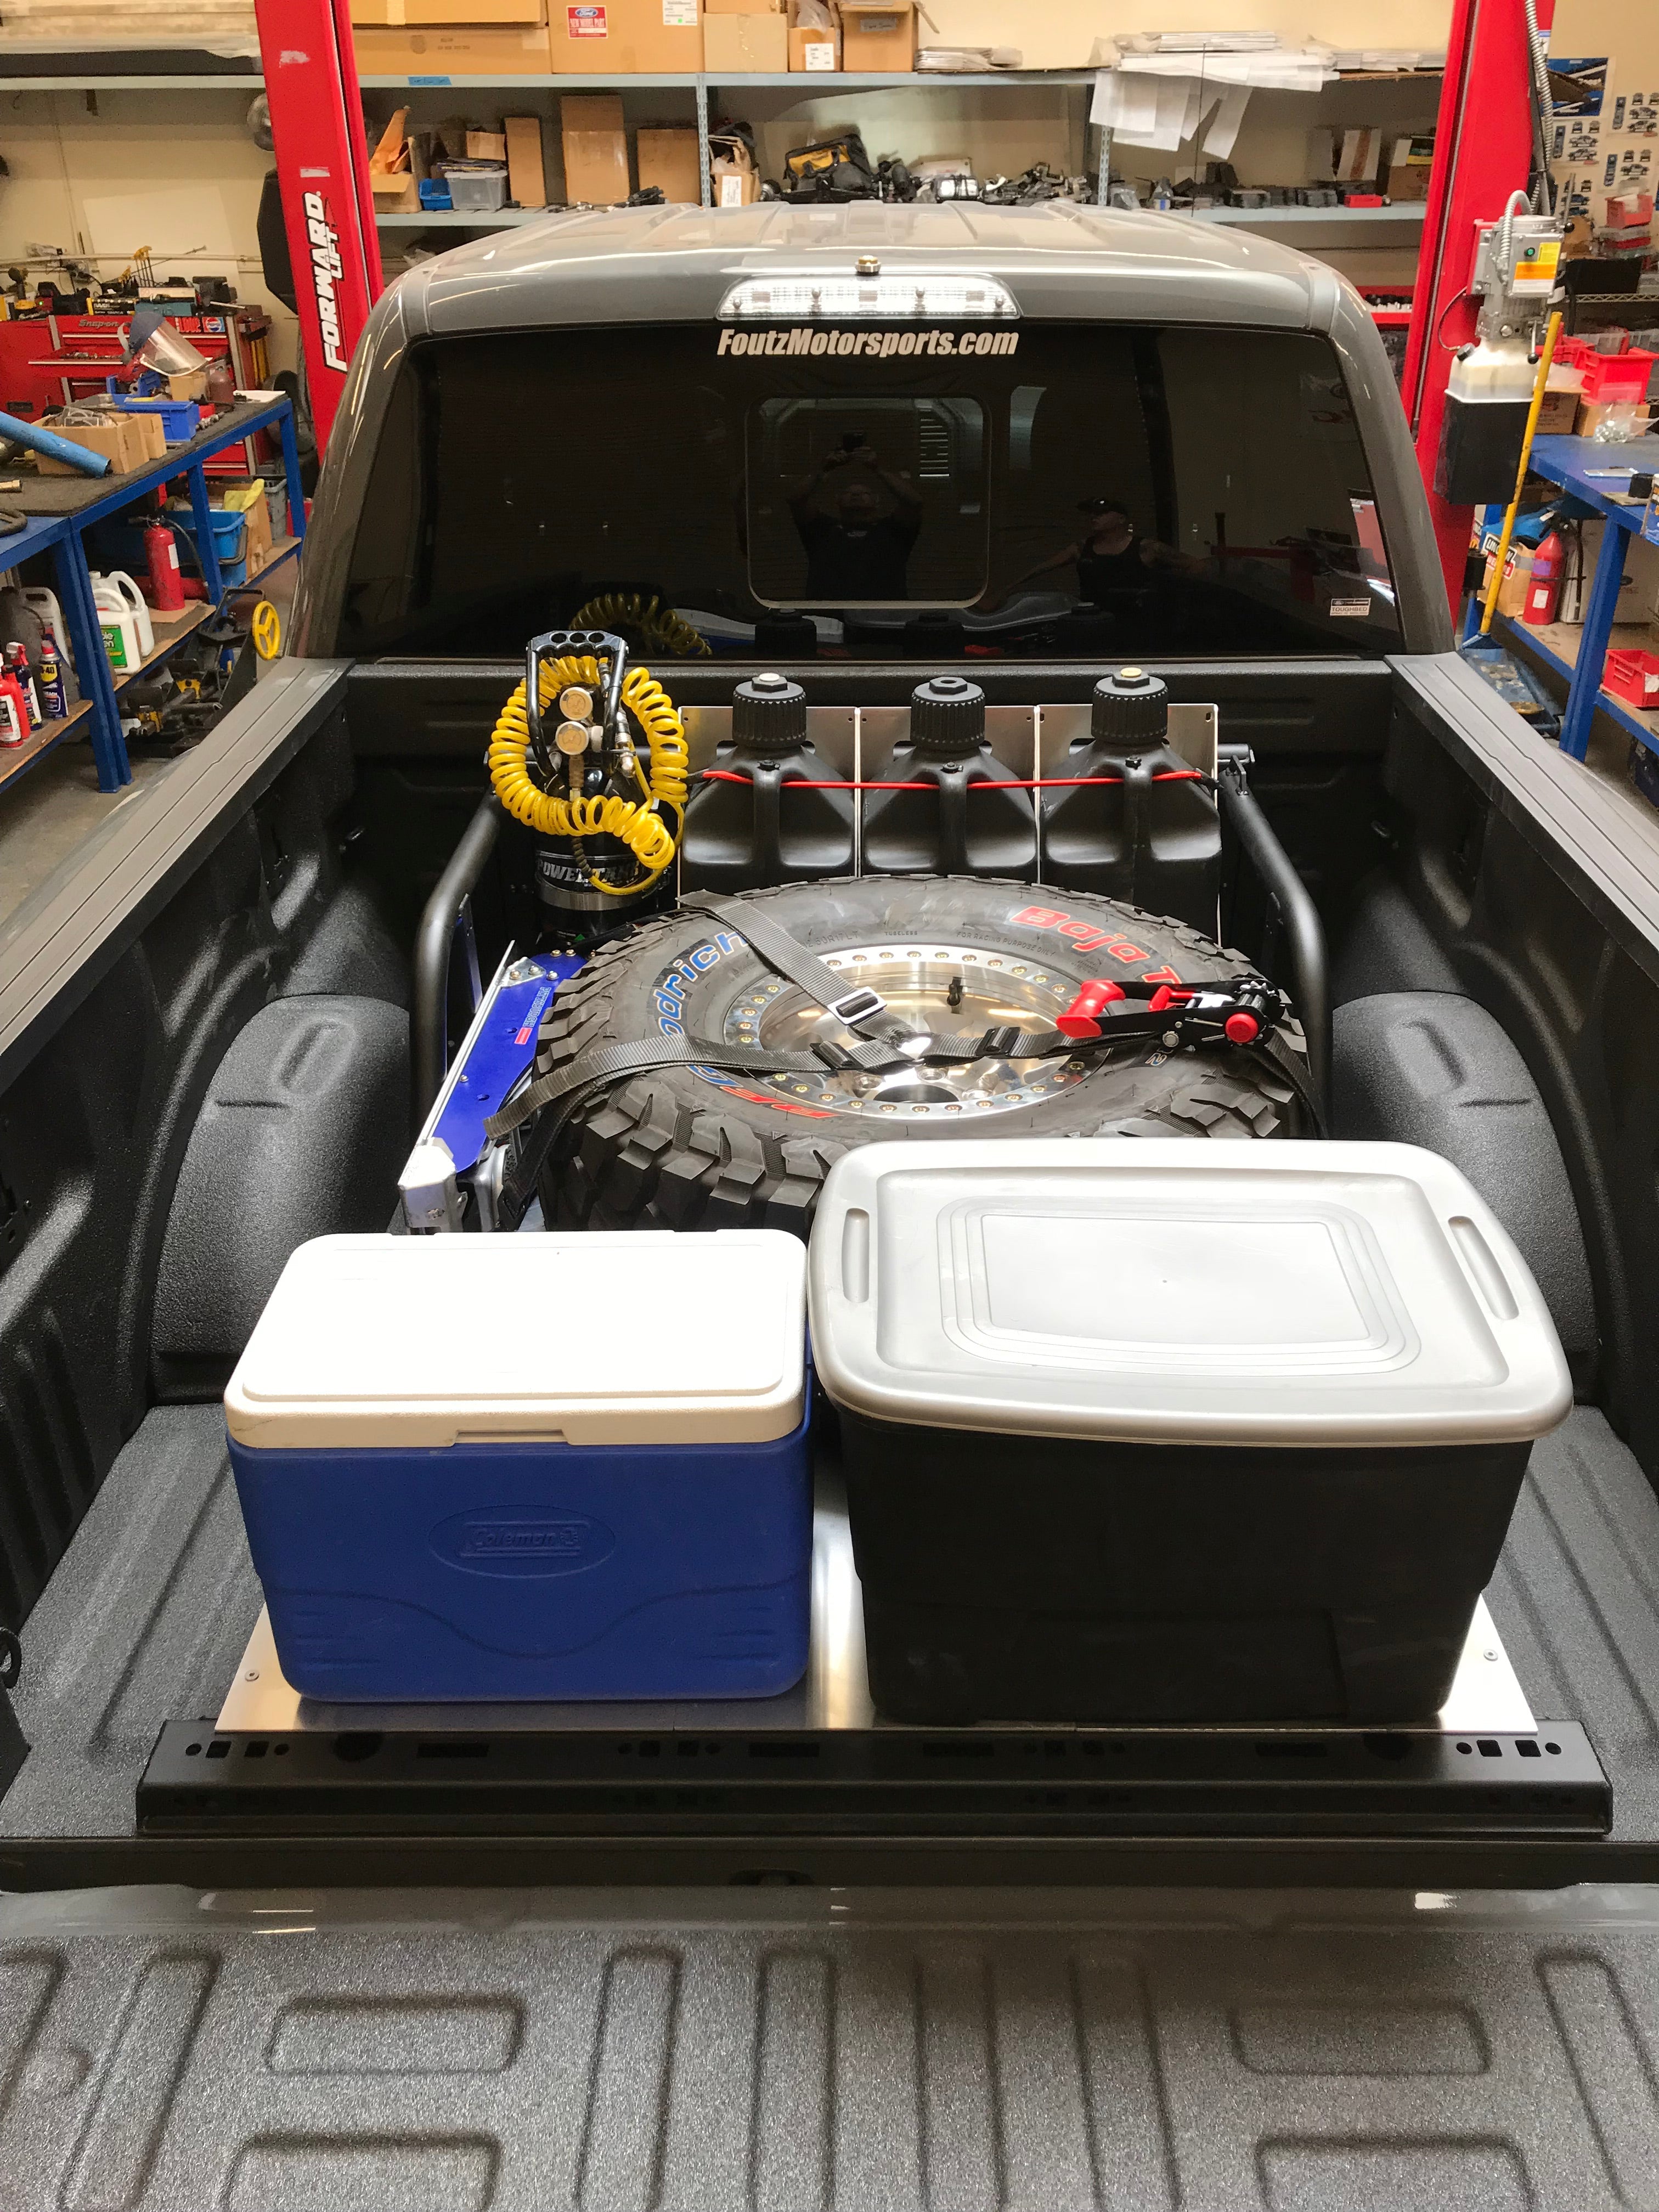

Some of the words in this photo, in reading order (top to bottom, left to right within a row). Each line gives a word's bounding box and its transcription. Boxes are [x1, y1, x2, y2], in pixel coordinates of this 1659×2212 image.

[325, 227, 343, 279] LIFT
[304, 192, 348, 373] FORWARD
[716, 329, 1019, 358] FoutzMotorsports.com
[973, 934, 1001, 943] RACING
[1002, 938, 1036, 951] PURPOSE
[1036, 947, 1056, 957] ONLY
[1009, 906, 1151, 963] Baja
[474, 1528, 557, 1546] Coleman
